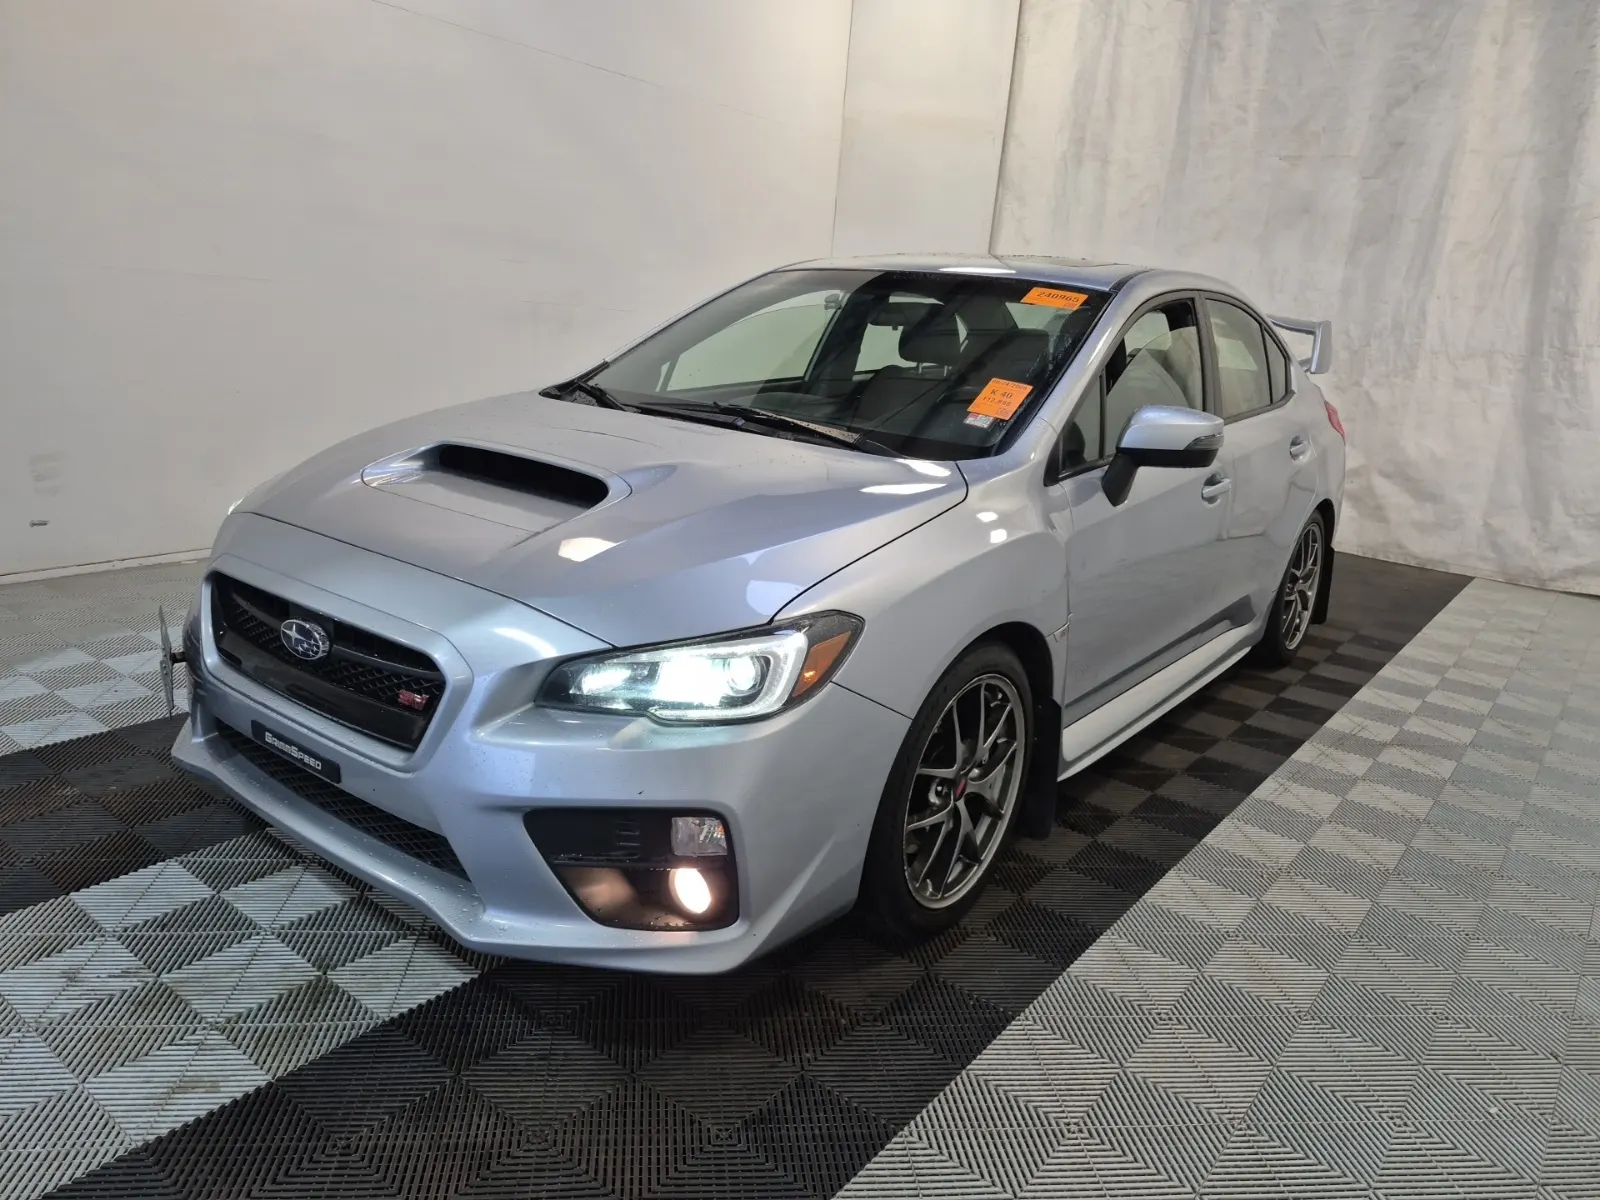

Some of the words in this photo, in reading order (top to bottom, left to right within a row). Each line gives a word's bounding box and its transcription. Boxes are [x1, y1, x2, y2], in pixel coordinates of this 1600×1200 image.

[1037, 291, 1080, 303] 240965
[990, 388, 1000, 396] K
[1000, 391, 1014, 399] 40
